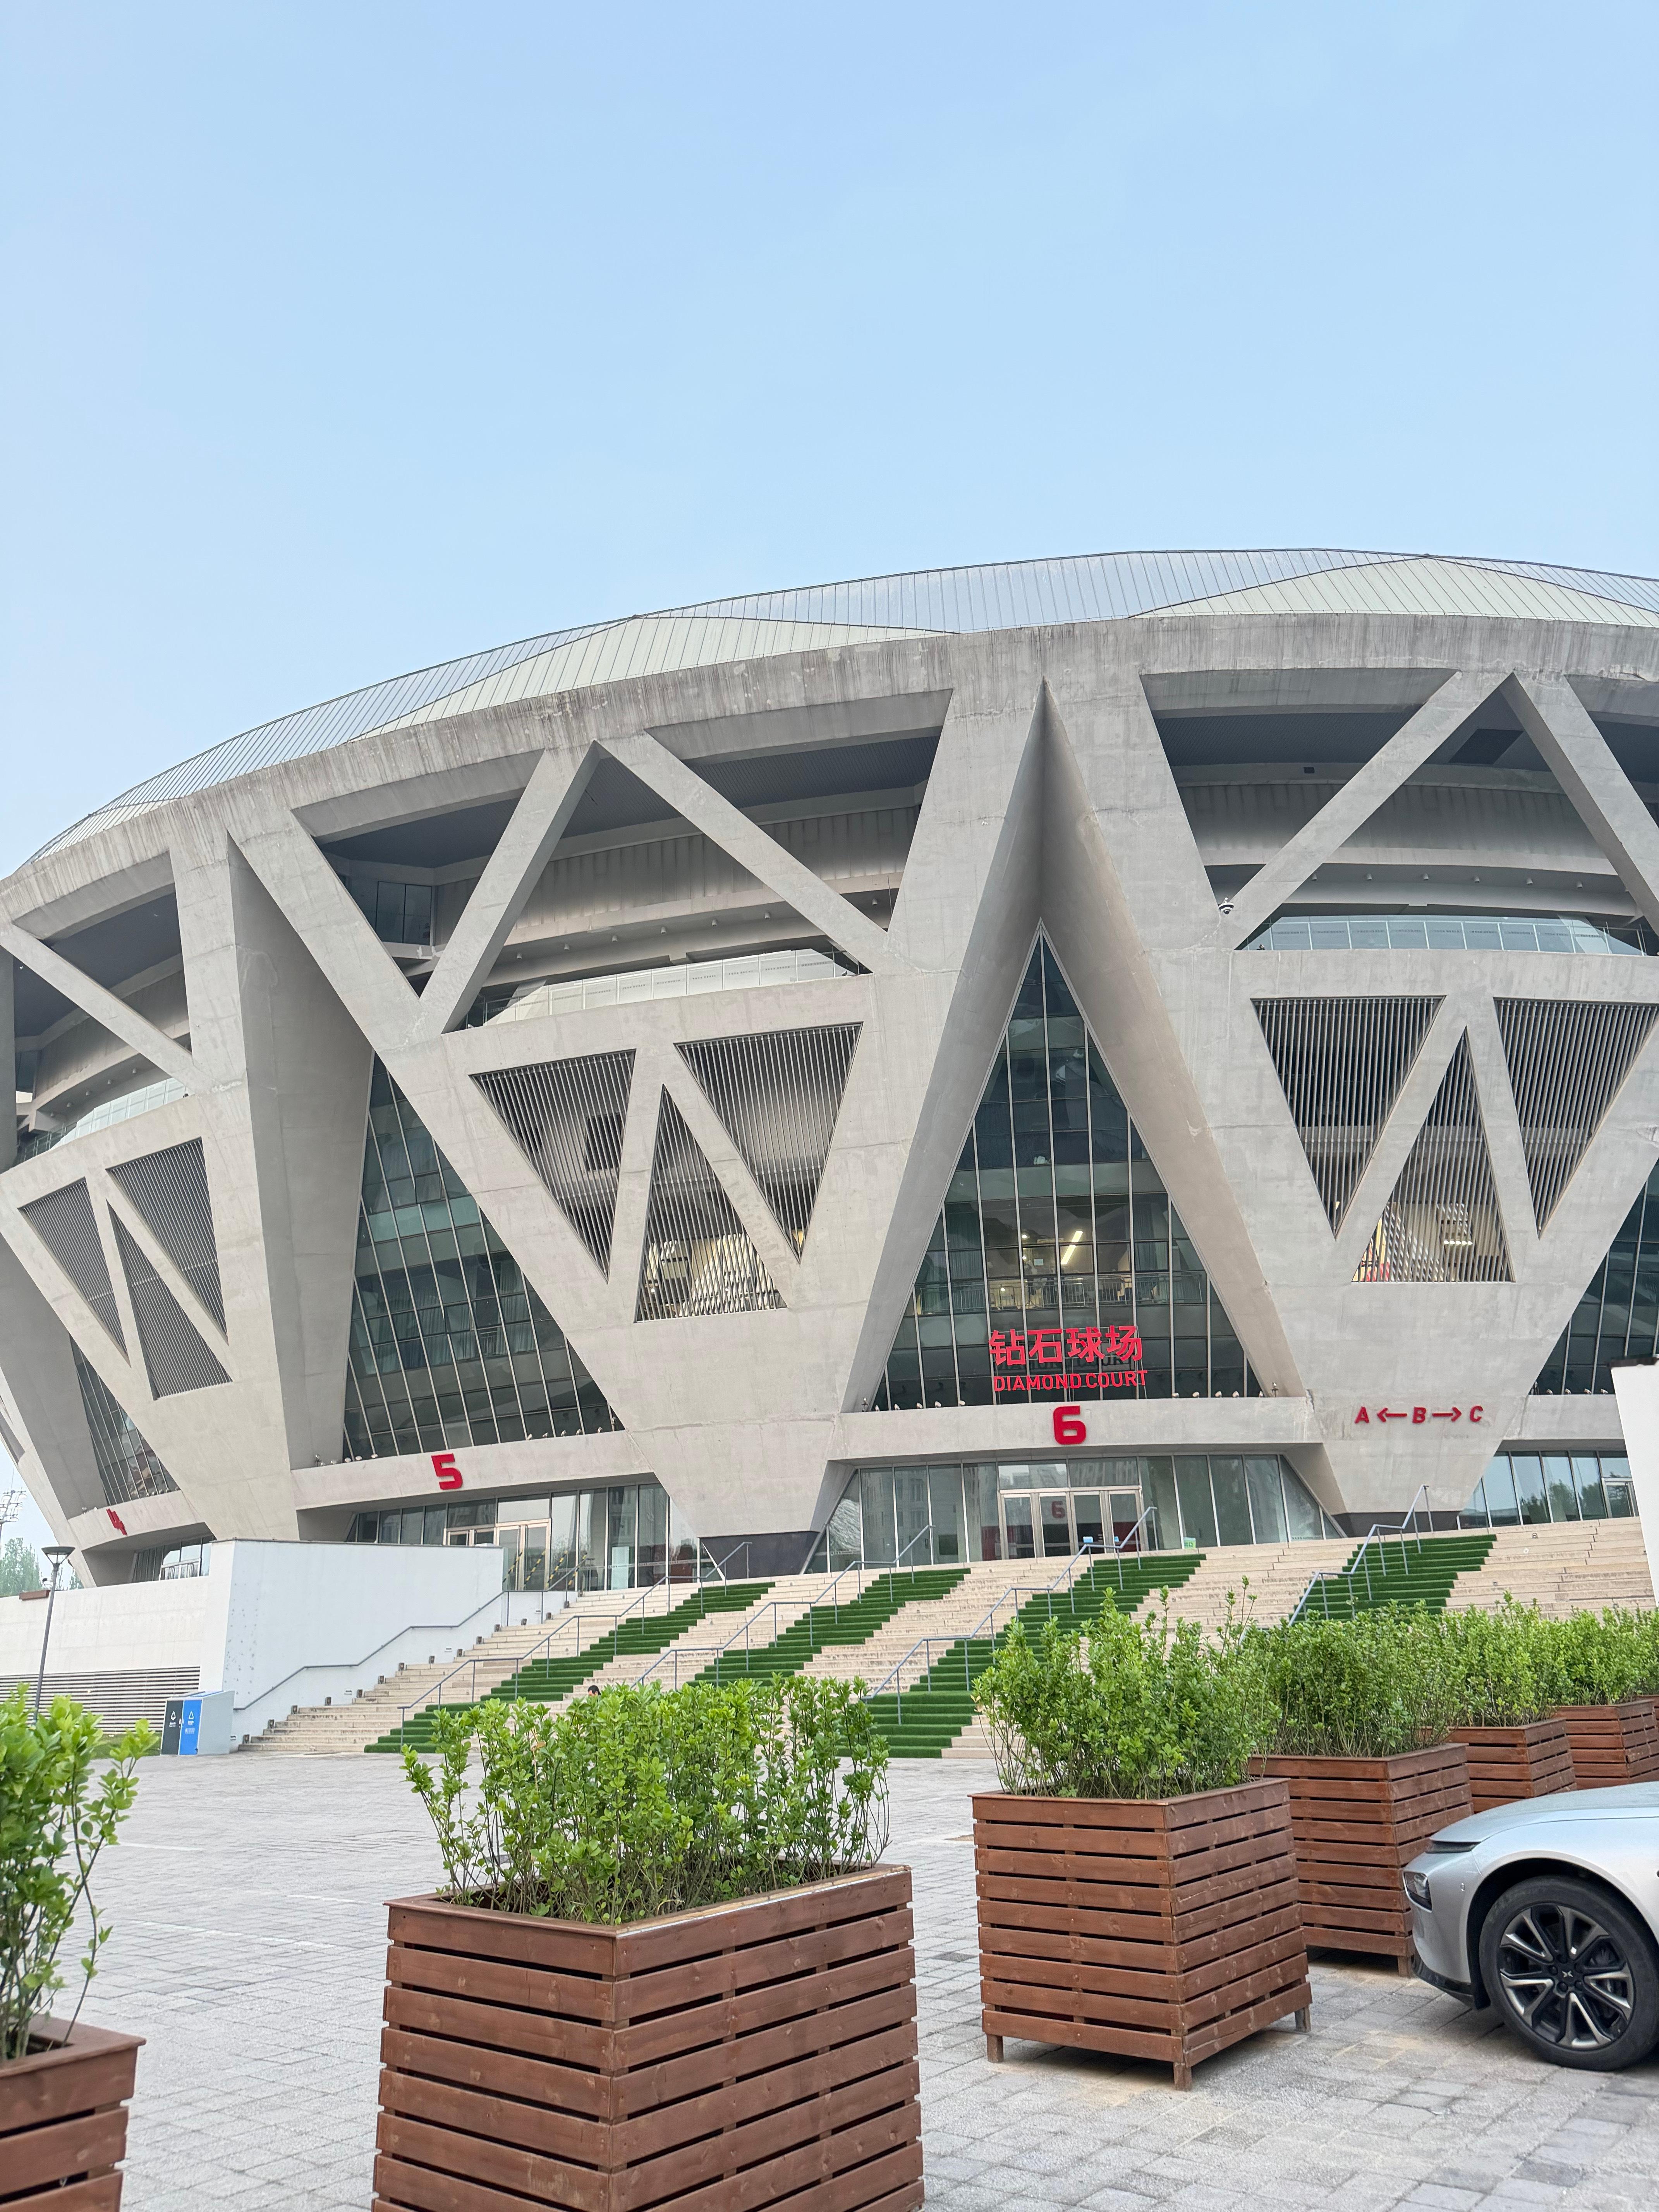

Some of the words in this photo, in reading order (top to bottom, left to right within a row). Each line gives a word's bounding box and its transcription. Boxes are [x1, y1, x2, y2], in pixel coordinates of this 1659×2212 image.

[988, 1325, 1142, 1366] 钻石球场
[993, 1373, 1082, 1392] DIAMOND
[1085, 1370, 1148, 1389] COURT
[1053, 1405, 1087, 1445] 6
[1355, 1406, 1370, 1424] A
[1412, 1407, 1427, 1424] B
[1470, 1405, 1483, 1422] C
[431, 1453, 463, 1491] 5
[1051, 1501, 1066, 1518] 6
